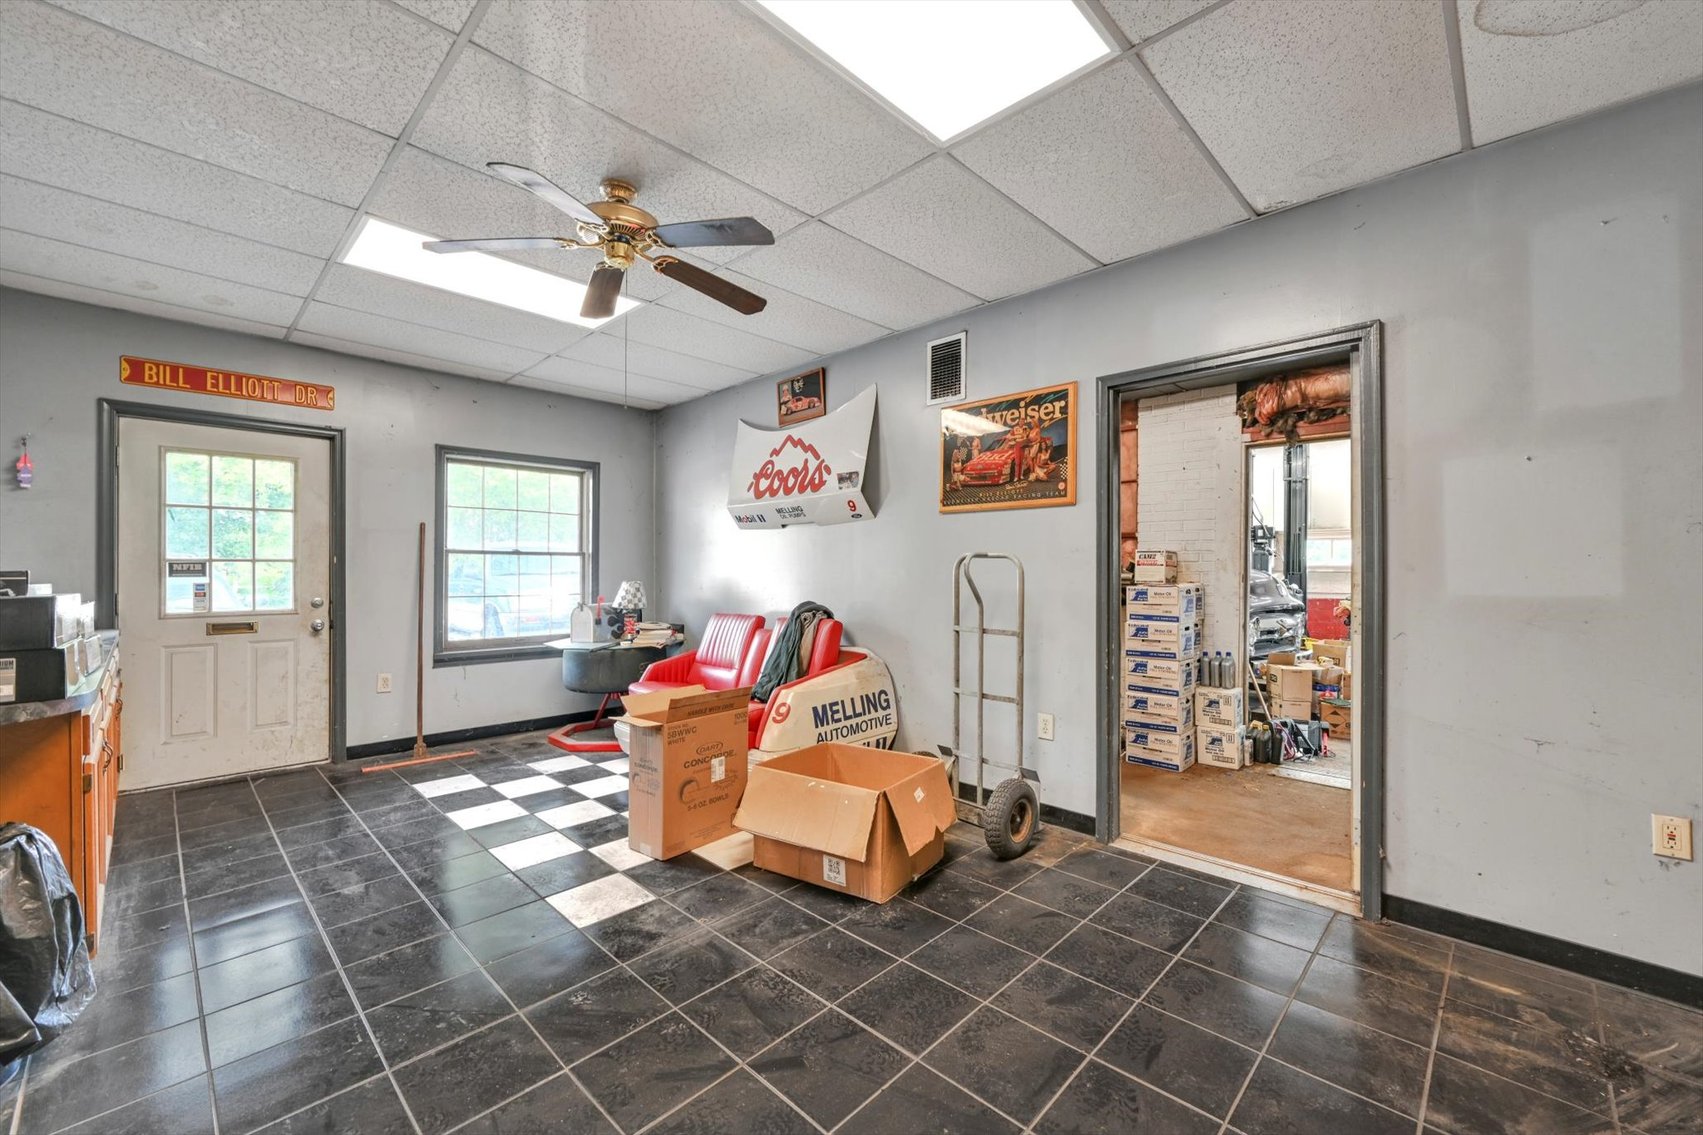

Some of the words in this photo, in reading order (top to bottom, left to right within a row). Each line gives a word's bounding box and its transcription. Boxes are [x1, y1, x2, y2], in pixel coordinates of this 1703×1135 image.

[144, 362, 190, 388] BILL
[206, 371, 281, 400] ELLIOTT
[295, 384, 317, 405] DR
[748, 458, 831, 499] Coors
[735, 514, 757, 523] Mobil
[775, 506, 803, 514] MELLING
[847, 500, 856, 512] 9
[772, 702, 791, 724] 9
[811, 689, 891, 729] MELLING
[816, 713, 893, 745] AUTOMOTIVE
